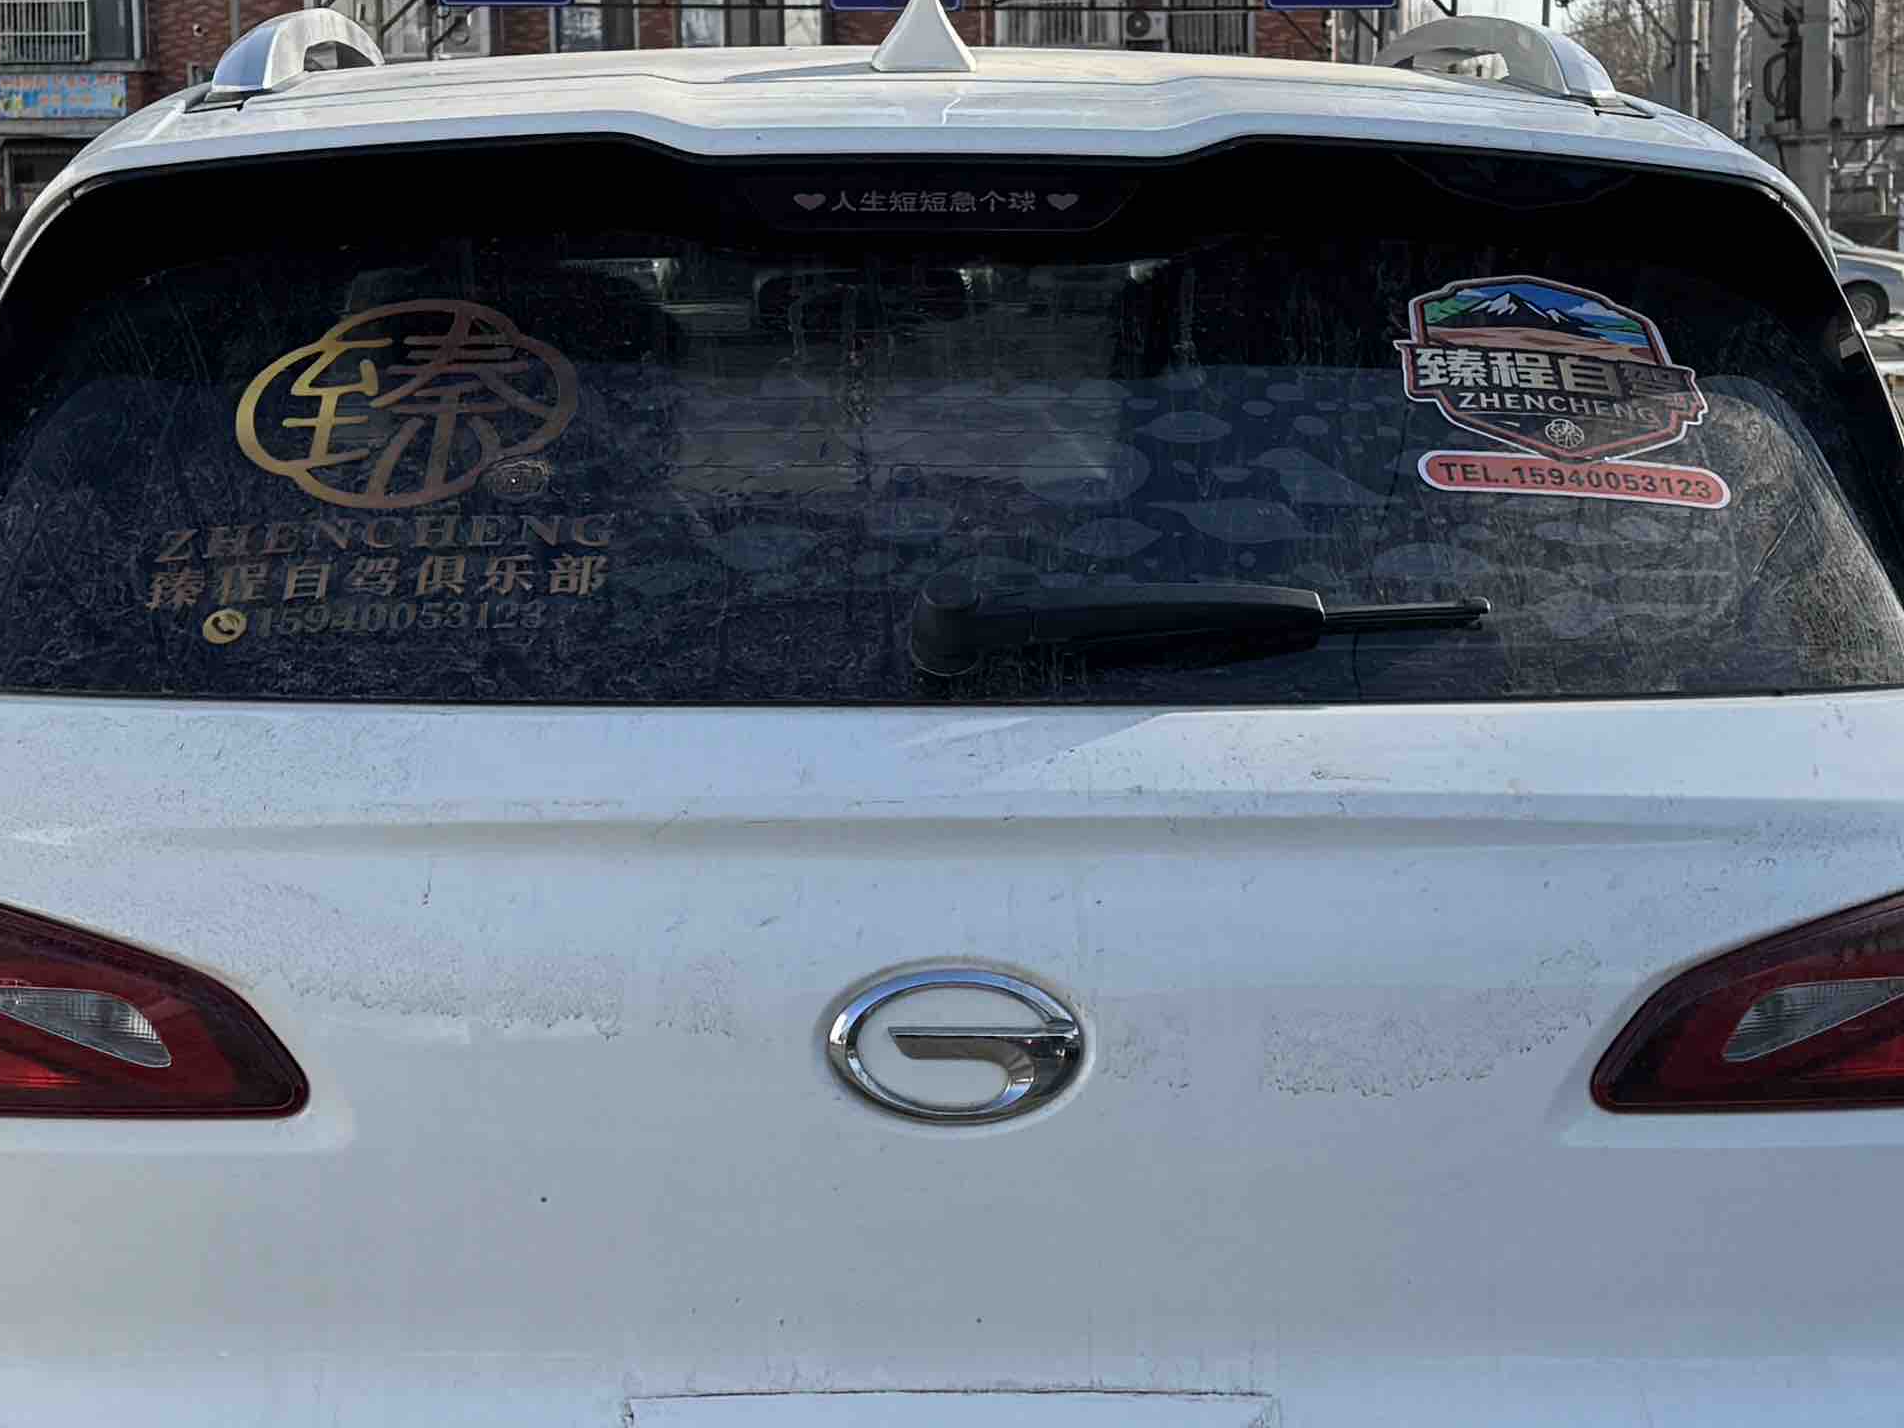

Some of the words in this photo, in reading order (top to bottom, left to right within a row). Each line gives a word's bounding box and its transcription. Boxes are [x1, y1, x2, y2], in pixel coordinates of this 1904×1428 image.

[830, 190, 1037, 213] 人生短短急个球
[1457, 391, 1660, 424] ZHENCHENG
[154, 514, 617, 565] ZHENCHENG
[145, 554, 611, 611] 臻程自驾俱乐部
[254, 601, 549, 639] 15940053123
